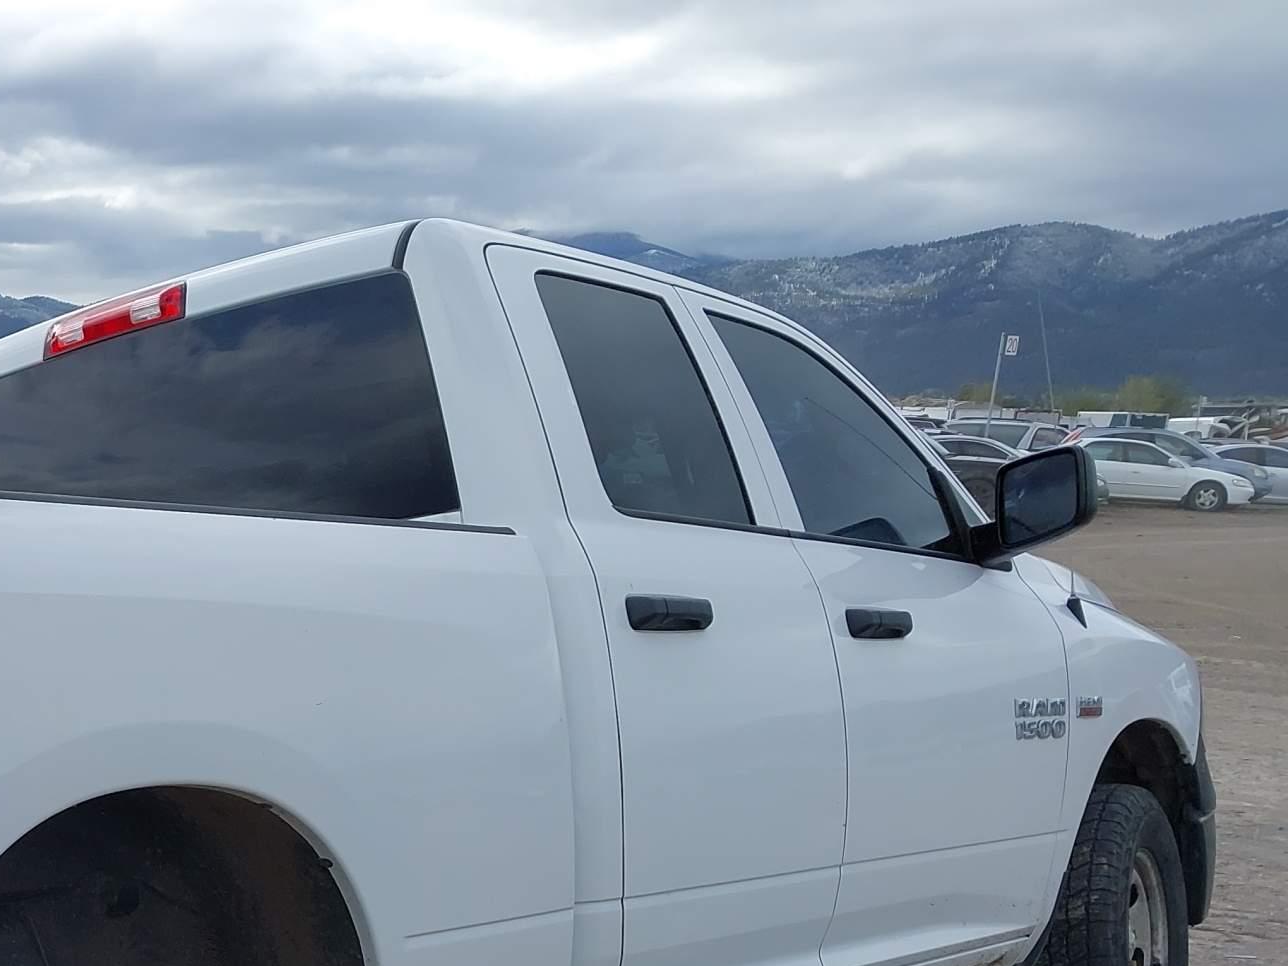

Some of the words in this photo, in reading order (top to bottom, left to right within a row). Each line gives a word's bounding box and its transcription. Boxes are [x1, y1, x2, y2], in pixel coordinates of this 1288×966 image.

[1006, 337, 1018, 353] 20
[1014, 698, 1066, 718] RAM
[1080, 695, 1103, 706] HEMI
[1015, 719, 1066, 740] 1500
